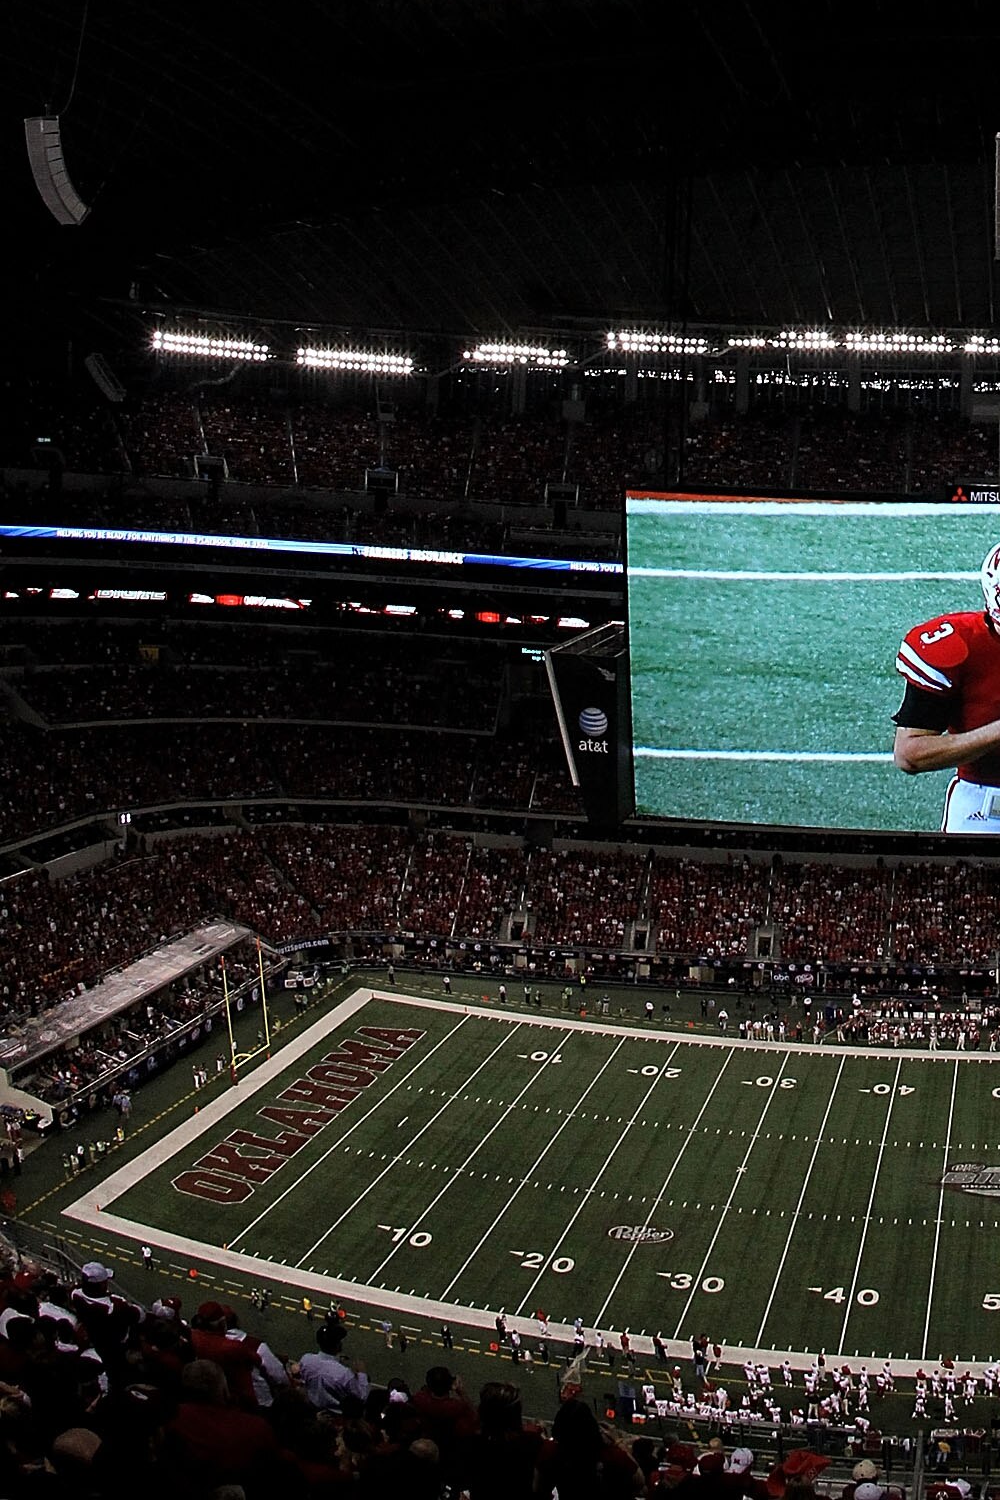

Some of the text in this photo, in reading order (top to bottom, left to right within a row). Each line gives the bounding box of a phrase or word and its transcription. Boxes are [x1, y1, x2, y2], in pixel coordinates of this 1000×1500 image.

[363, 546, 463, 564] FARMERS INSURANCE
[920, 621, 954, 644] 3
[578, 738, 609, 754] at&t
[170, 1025, 428, 1205] OKLAHOMA
[390, 1227, 433, 1249] 10
[520, 1251, 576, 1274] 20
[669, 1273, 725, 1294] 30
[823, 1286, 880, 1307] 40
